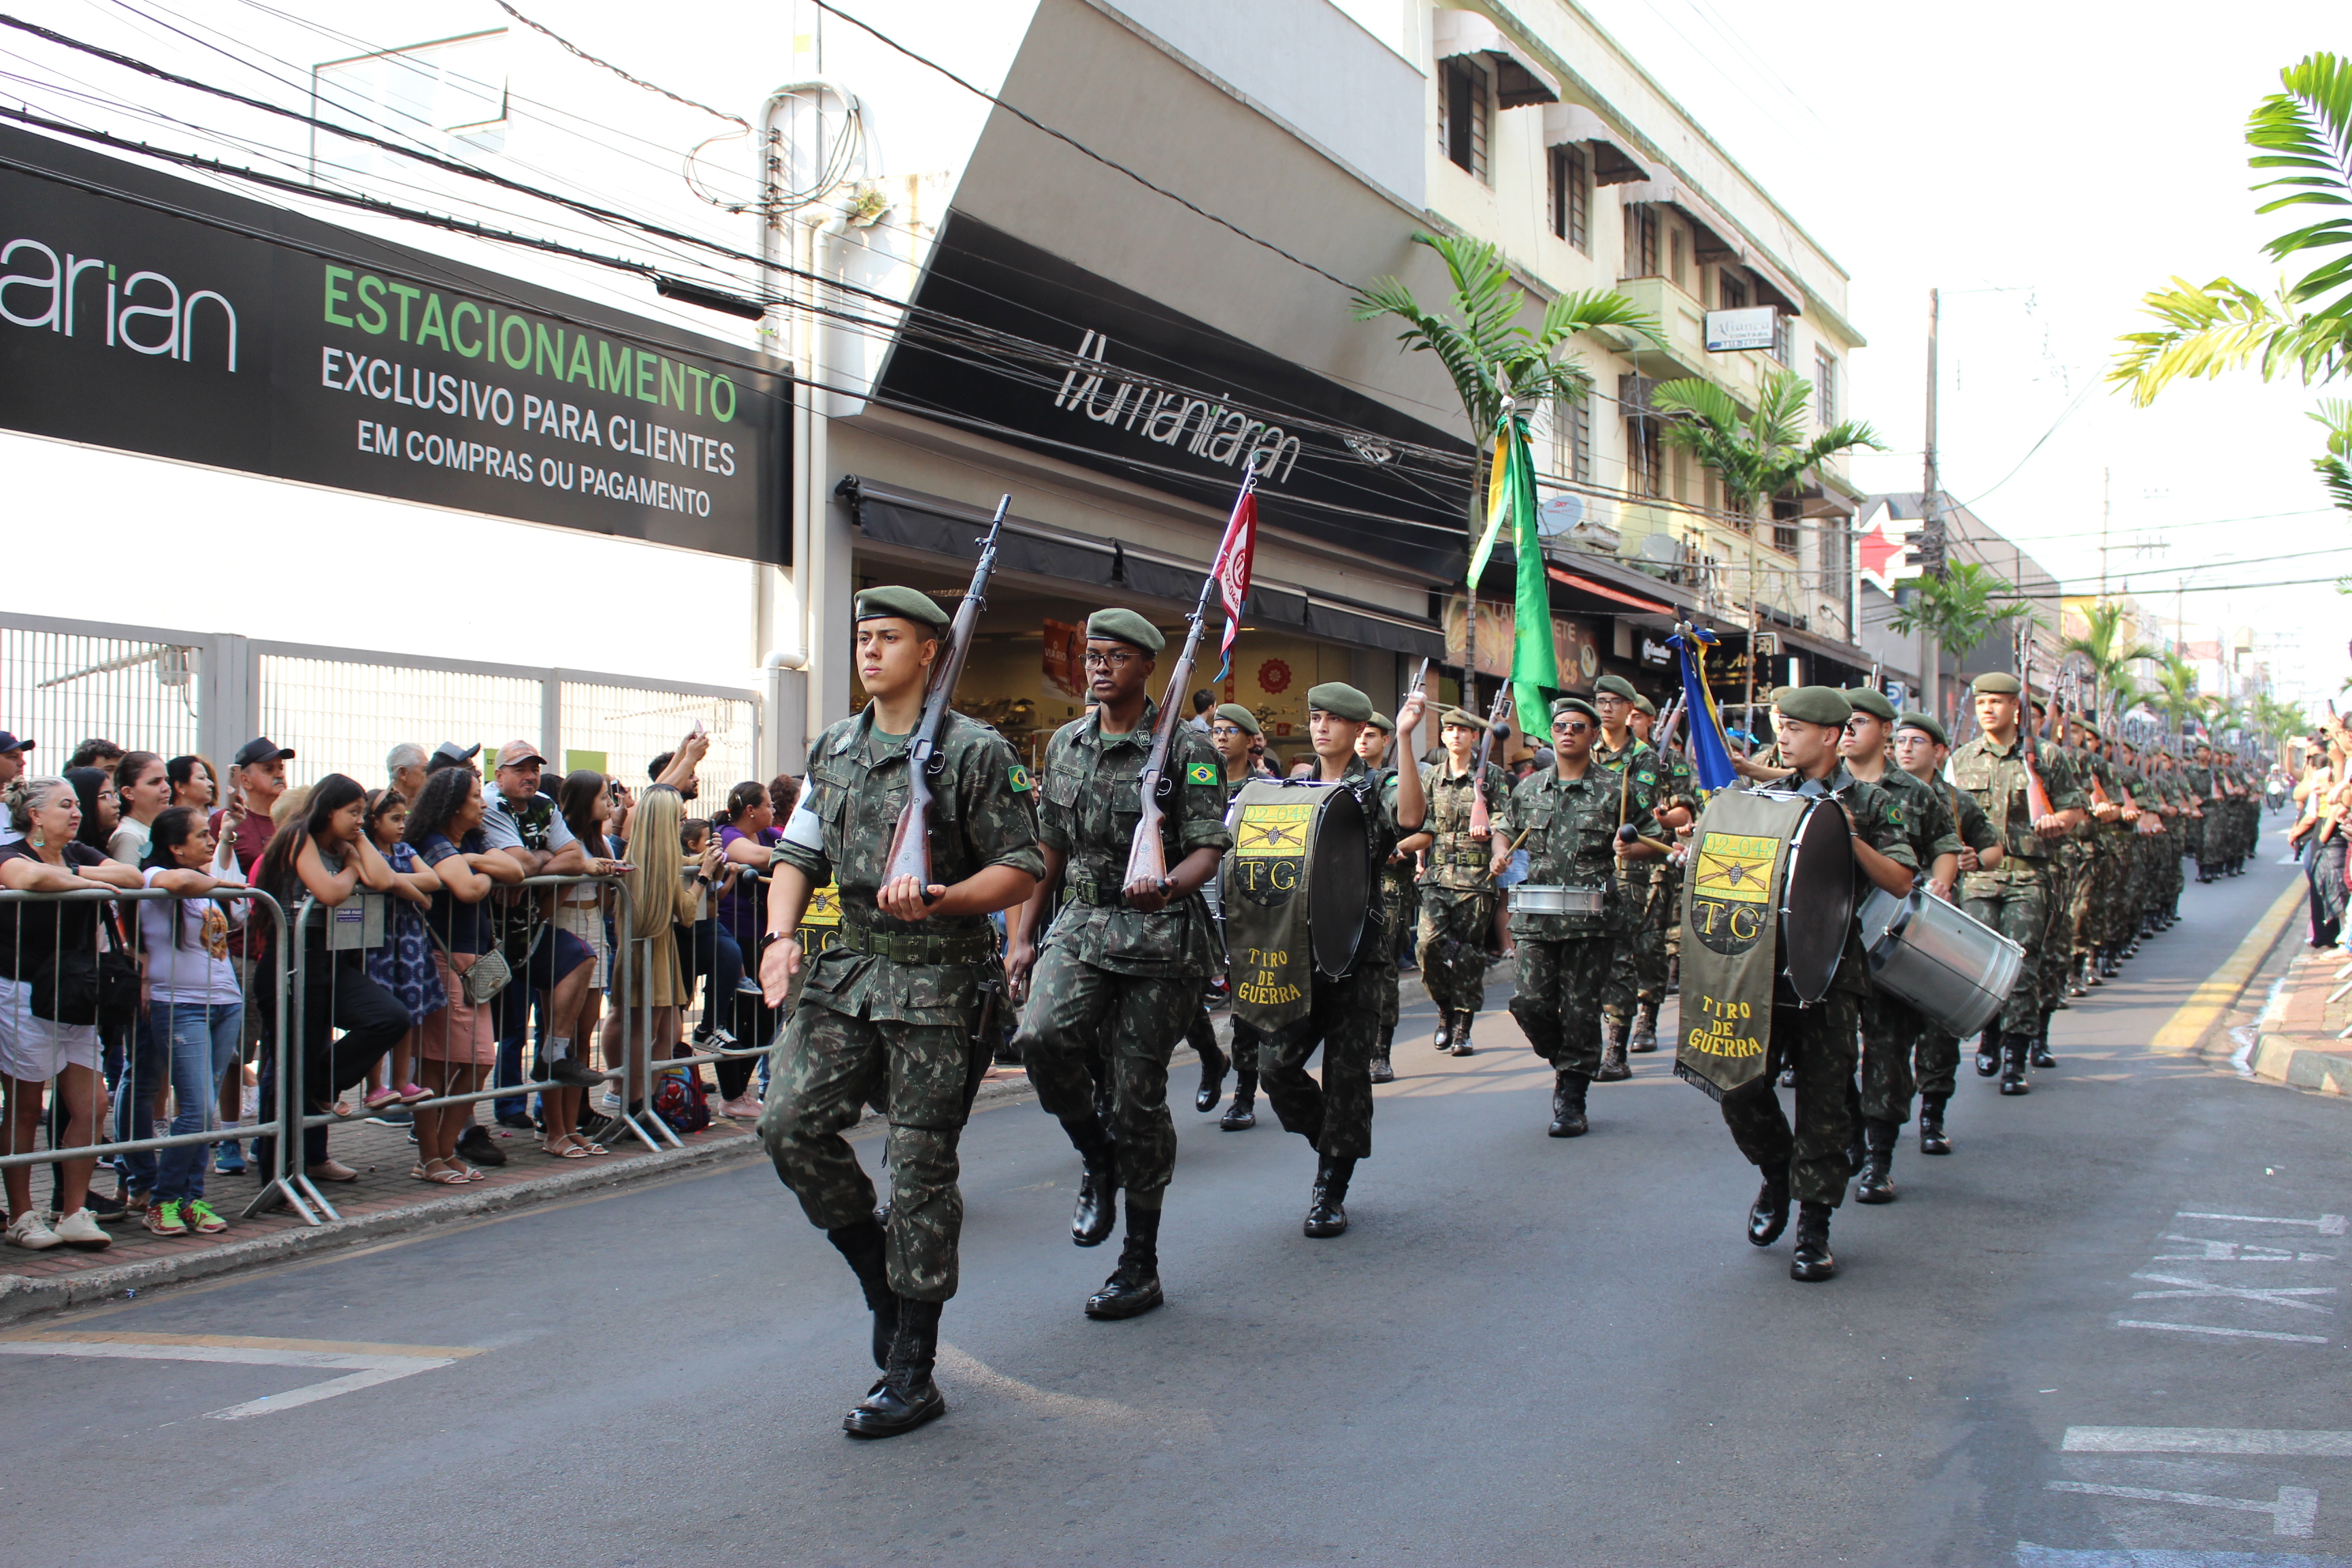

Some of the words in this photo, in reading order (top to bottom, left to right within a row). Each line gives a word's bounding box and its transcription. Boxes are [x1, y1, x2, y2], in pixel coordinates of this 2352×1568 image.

[0, 238, 237, 373] arian
[325, 265, 736, 423] ESTACIONAMENTO
[322, 346, 514, 426] EXCLUSIVO
[523, 394, 602, 446] PARA
[608, 415, 736, 476] CLIENTES
[358, 419, 398, 457] EM
[406, 431, 534, 483] COMPRAS
[540, 457, 574, 490] OU
[581, 465, 710, 517] PAGAMENTO
[1245, 806, 1311, 822] 02-048
[1703, 834, 1777, 859] 02-048
[1249, 948, 1288, 967] TIRO
[1257, 970, 1275, 986] DE
[1239, 981, 1302, 1004] GUERRA
[1702, 995, 1751, 1019] TIRO
[1710, 1019, 1734, 1037] DE
[1688, 1028, 1763, 1058] GUERRA
